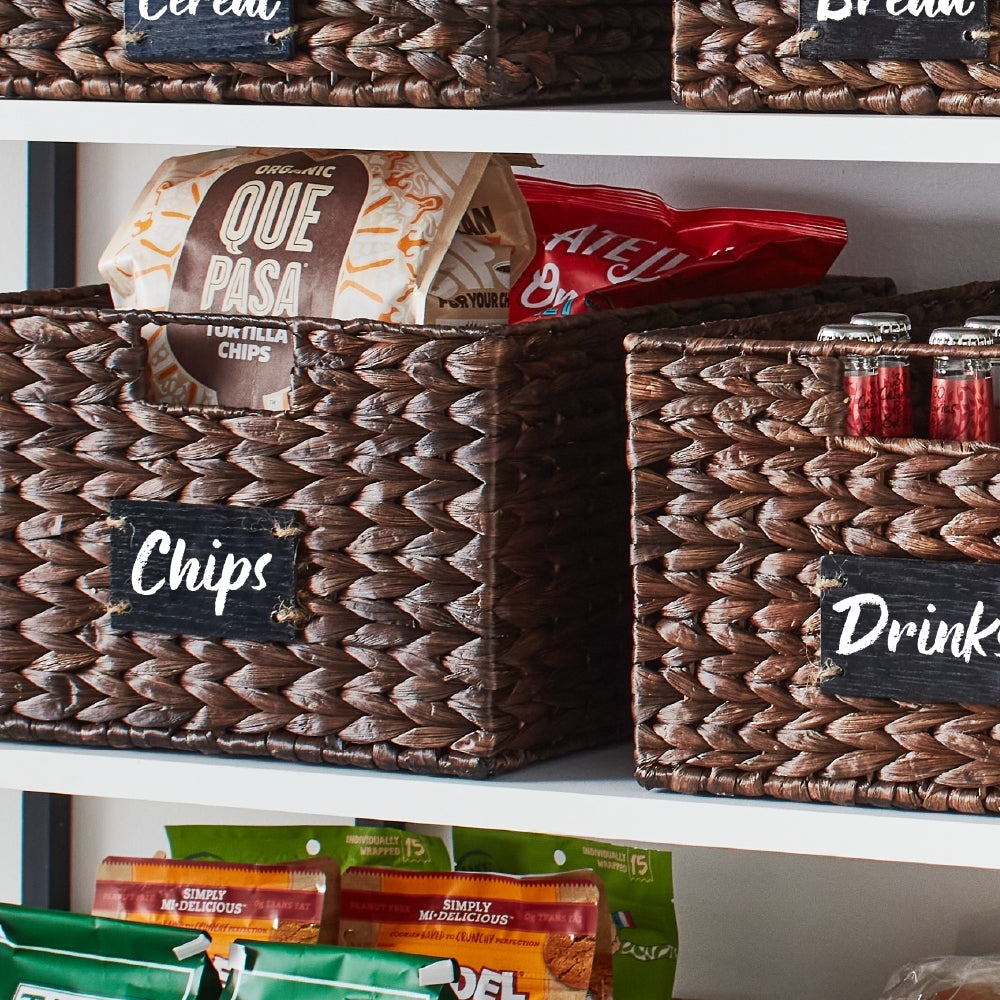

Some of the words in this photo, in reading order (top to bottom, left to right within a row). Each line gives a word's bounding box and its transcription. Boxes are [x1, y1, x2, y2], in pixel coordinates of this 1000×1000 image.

[219, 179, 335, 255] QUE
[200, 254, 302, 317] PASA
[467, 292, 499, 308] YOUR
[218, 341, 272, 363] CHIPS
[131, 529, 273, 617] Chips
[345, 834, 399, 846] INDIVIDUALLY
[405, 837, 425, 857] 15
[360, 846, 400, 856] WRAPPED
[630, 854, 648, 876] 15
[182, 887, 227, 902] SIMPLY
[442, 899, 492, 914] SIMPLY
[455, 931, 495, 945] CRUNCHY
[495, 937, 541, 948] PERFECTION
